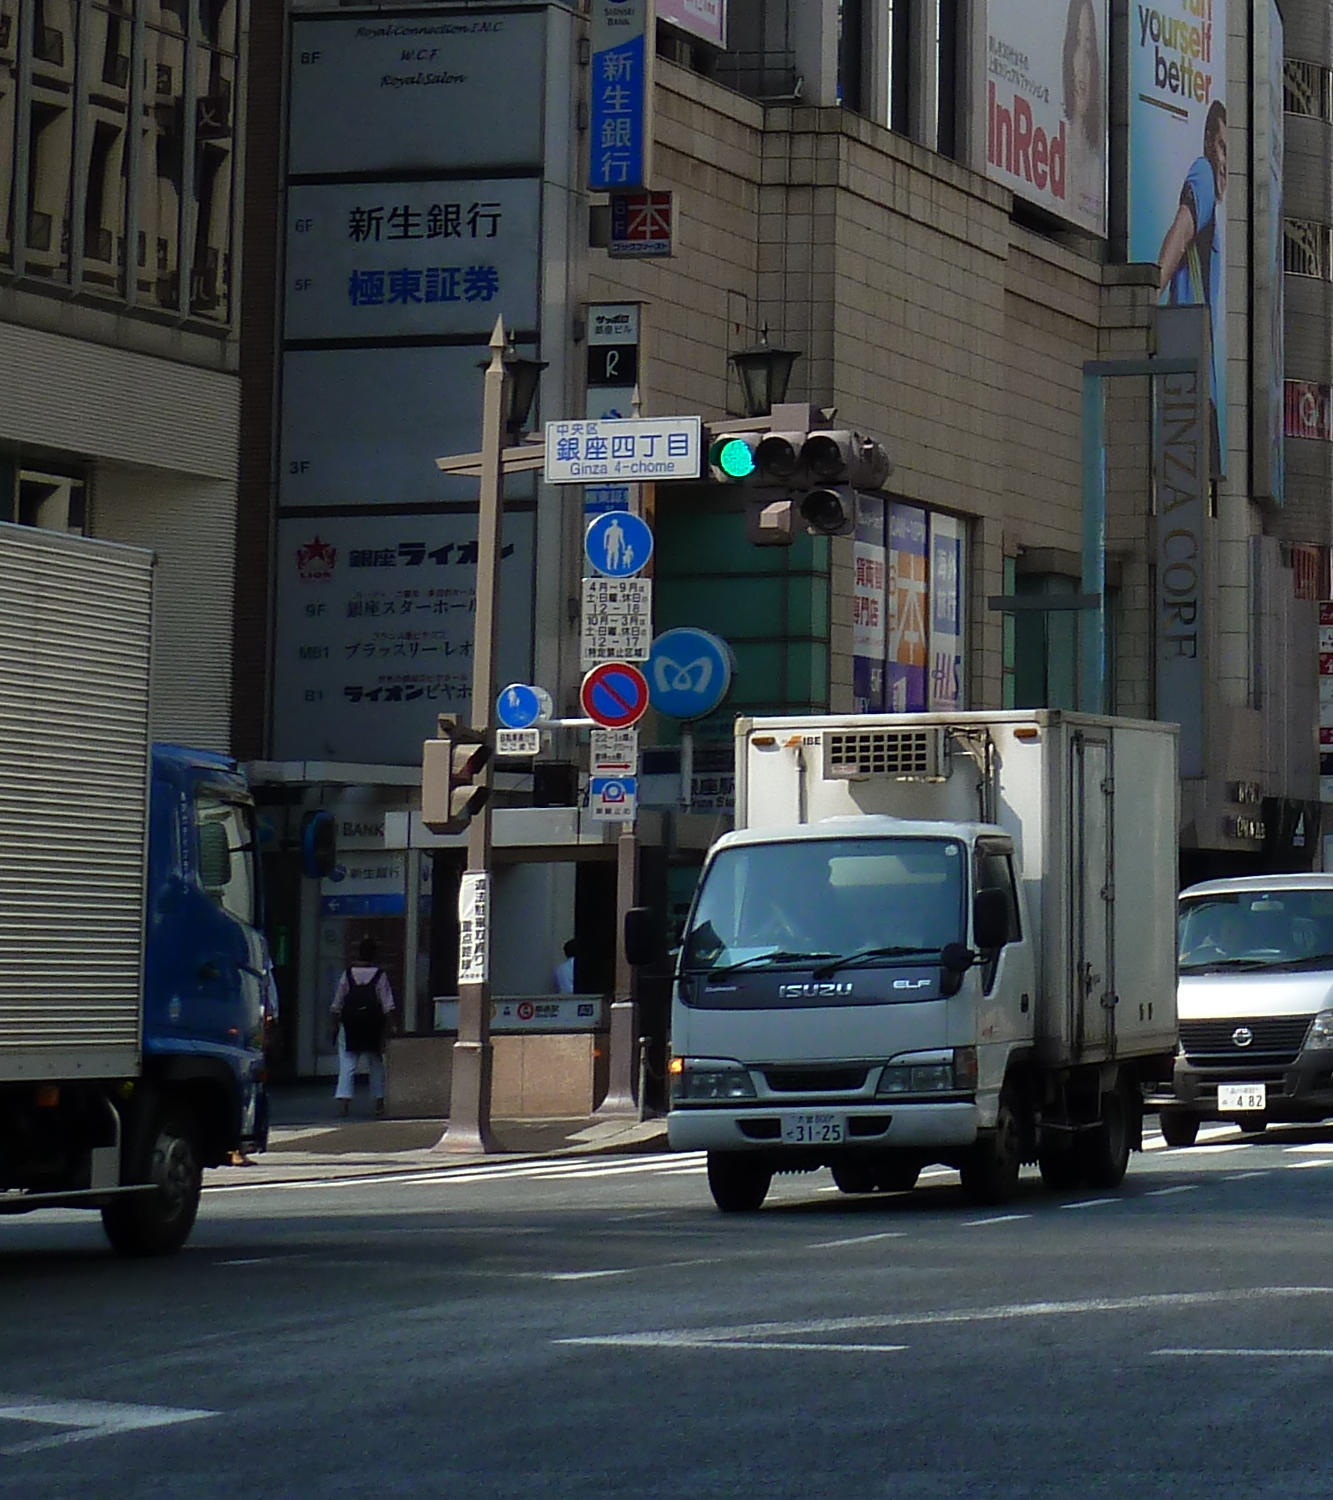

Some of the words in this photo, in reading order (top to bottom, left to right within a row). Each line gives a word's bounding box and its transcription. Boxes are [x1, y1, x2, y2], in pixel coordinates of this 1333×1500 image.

[1138, 3, 1212, 63] yourself
[1155, 46, 1212, 102] better
[601, 51, 632, 183] 新生銀行
[987, 79, 1066, 200] InRed
[349, 202, 502, 242] 新生銀行
[349, 265, 500, 306] 極東証券
[556, 433, 688, 461] 銀座四丁目
[557, 422, 598, 436] 中央区
[1162, 372, 1198, 512] GINZA
[570, 462, 608, 476] Ginza
[614, 460, 675, 474] 4-chome
[343, 822, 385, 837] BANK
[779, 983, 853, 999] ISUZU
[893, 979, 933, 989] ELF
[797, 1125, 841, 1142] 31-25
